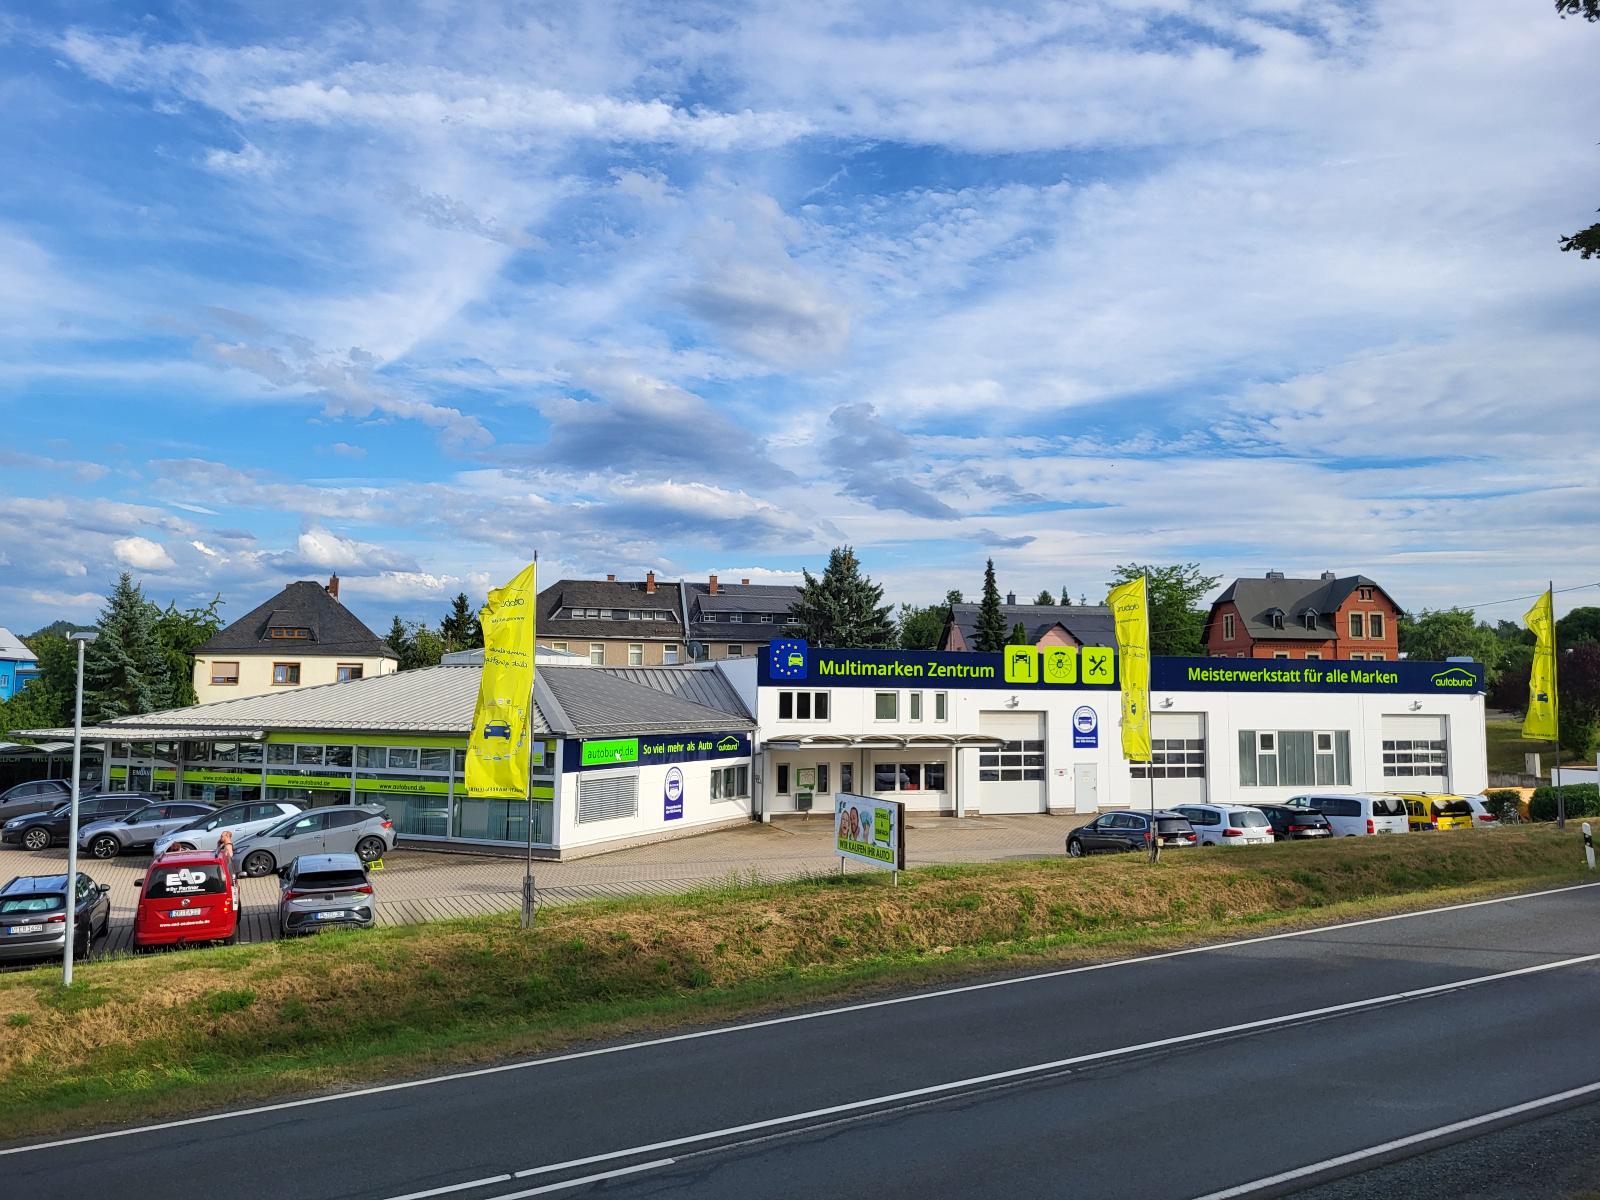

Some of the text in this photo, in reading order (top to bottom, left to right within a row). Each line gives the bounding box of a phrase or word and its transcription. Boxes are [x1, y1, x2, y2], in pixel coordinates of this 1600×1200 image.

[819, 659, 995, 679] Multimarken Zentrum
[1188, 667, 1398, 685] Meisterwerkstatt für alle Marken
[1435, 676, 1473, 688] autobund
[587, 744, 634, 760] autobund.de
[643, 741, 713, 755] So viel mehr als Auto
[719, 743, 737, 752] autobund
[379, 783, 426, 791] www.autobund.de
[839, 840, 890, 860] WIR KAUFEN IHR AUTO
[167, 869, 206, 886] EAD
